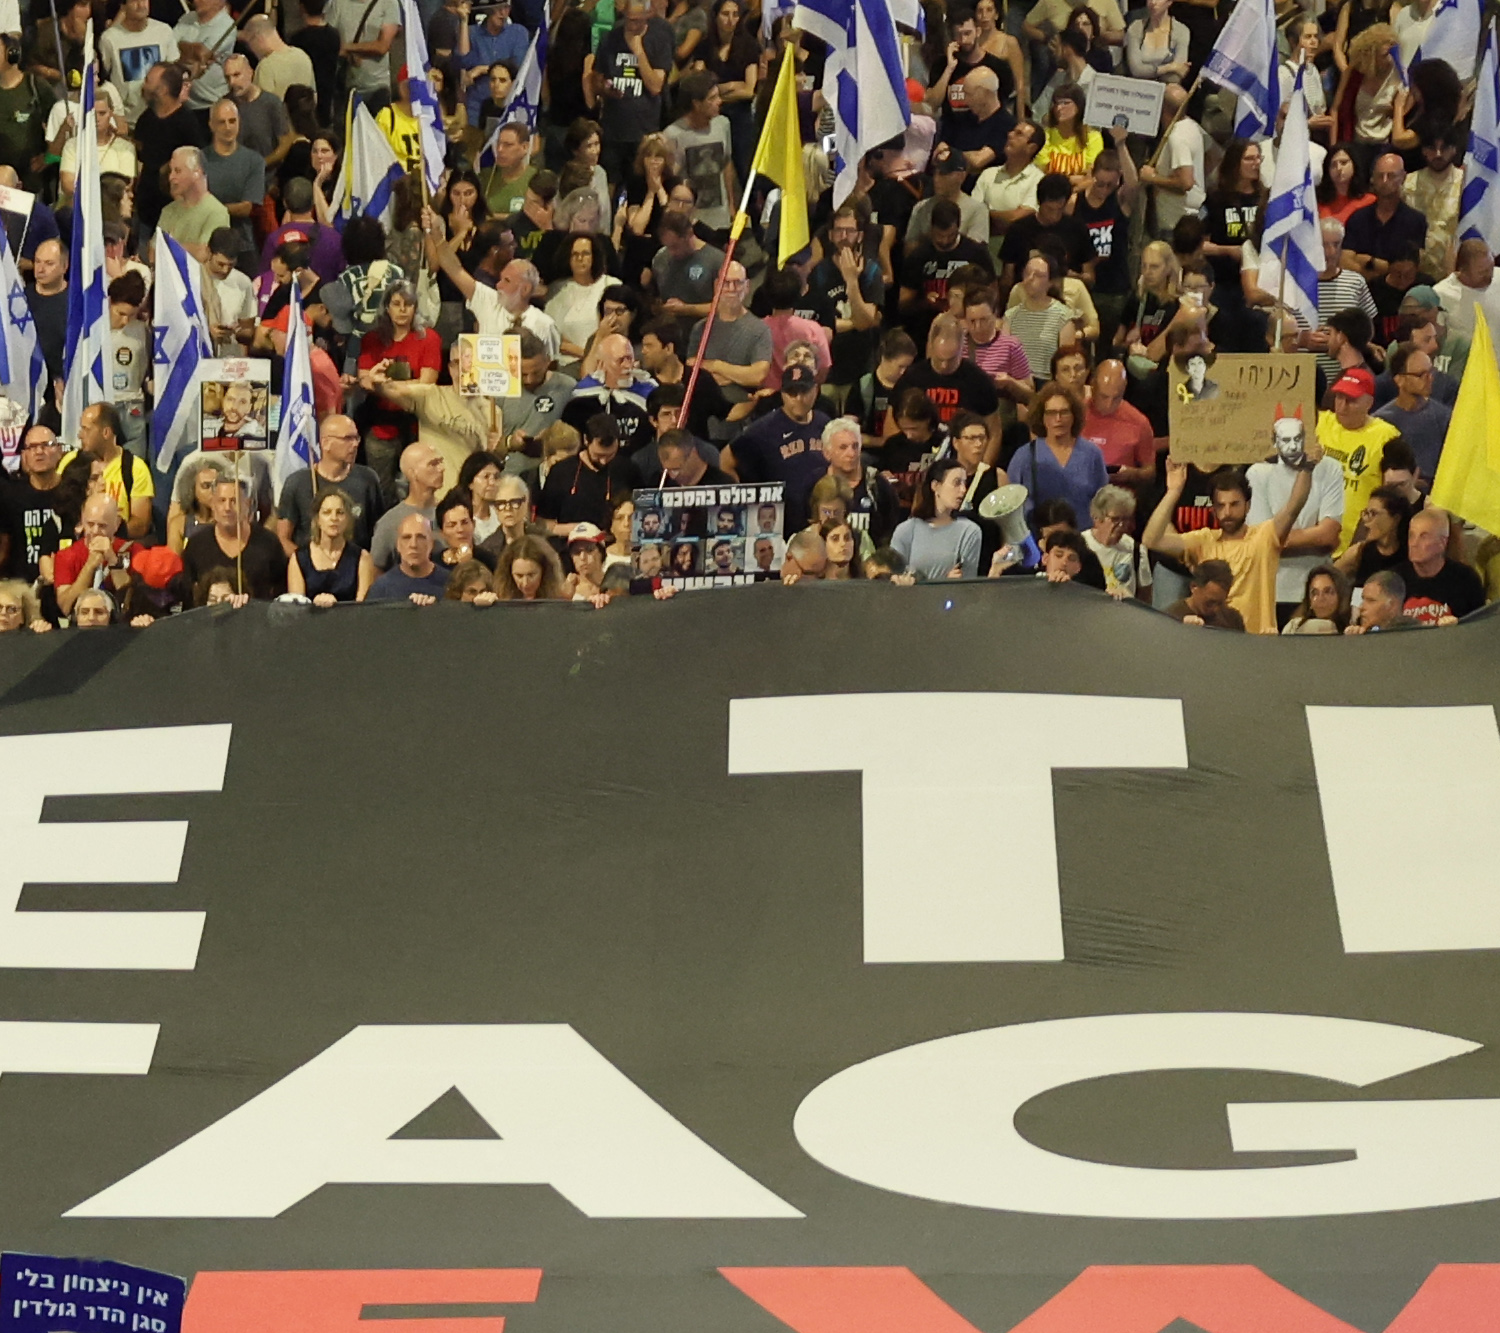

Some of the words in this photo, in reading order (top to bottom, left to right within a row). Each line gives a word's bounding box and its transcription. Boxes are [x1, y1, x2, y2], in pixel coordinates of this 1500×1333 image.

[662, 492, 717, 508] בהסכם
[721, 488, 760, 506] כולם
[767, 486, 783, 501] את
[15, 1266, 55, 1291] בלי
[66, 1272, 131, 1300] ניצחון
[136, 1282, 170, 1307] אין
[13, 1296, 77, 1324] גולדין
[82, 1303, 127, 1326] הדר
